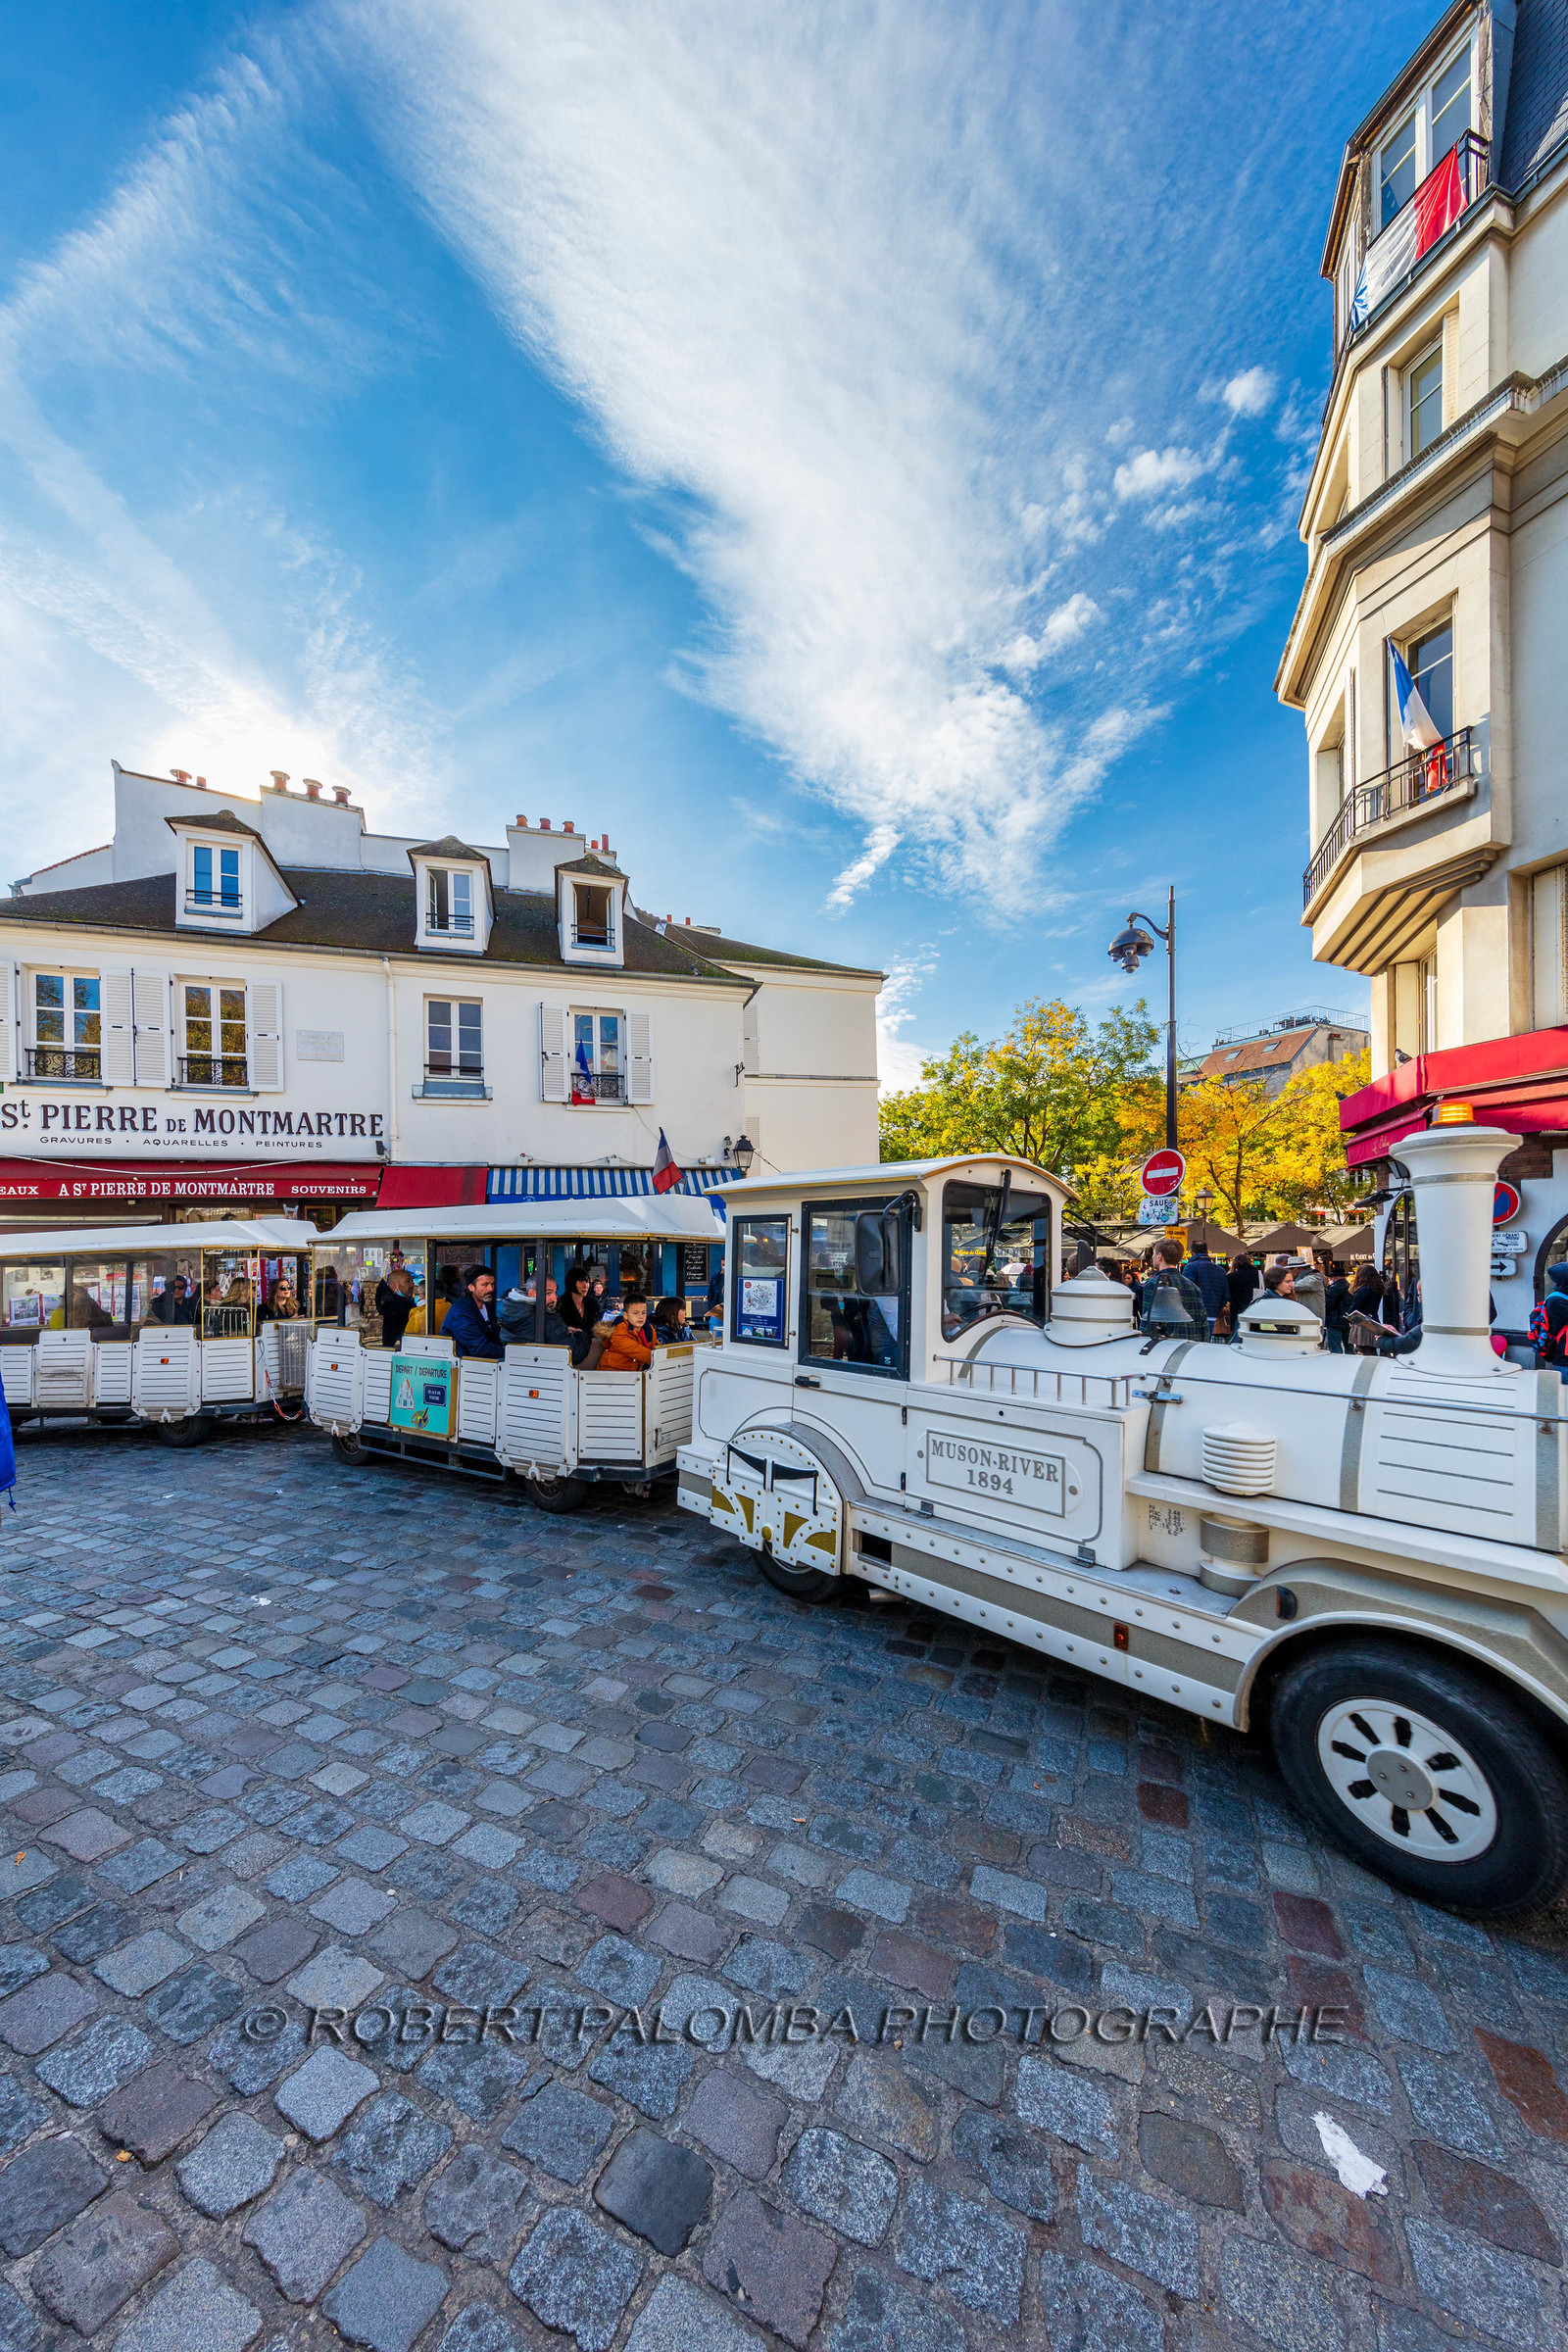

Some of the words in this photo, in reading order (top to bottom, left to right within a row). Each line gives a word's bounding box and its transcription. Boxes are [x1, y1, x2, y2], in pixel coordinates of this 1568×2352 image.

[40, 1104, 158, 1133] PIERRE
[166, 1118, 187, 1132] DE
[194, 1108, 384, 1137] MONTMARTRE
[59, 1184, 70, 1197] A
[90, 1182, 146, 1196] PIERRE
[150, 1182, 172, 1196] DE
[173, 1182, 274, 1196] MONTMARTRE
[291, 1185, 367, 1195] SOUVENIRS
[418, 1367, 448, 1379] DEPARTURE
[966, 1468, 1014, 1495] 1894
